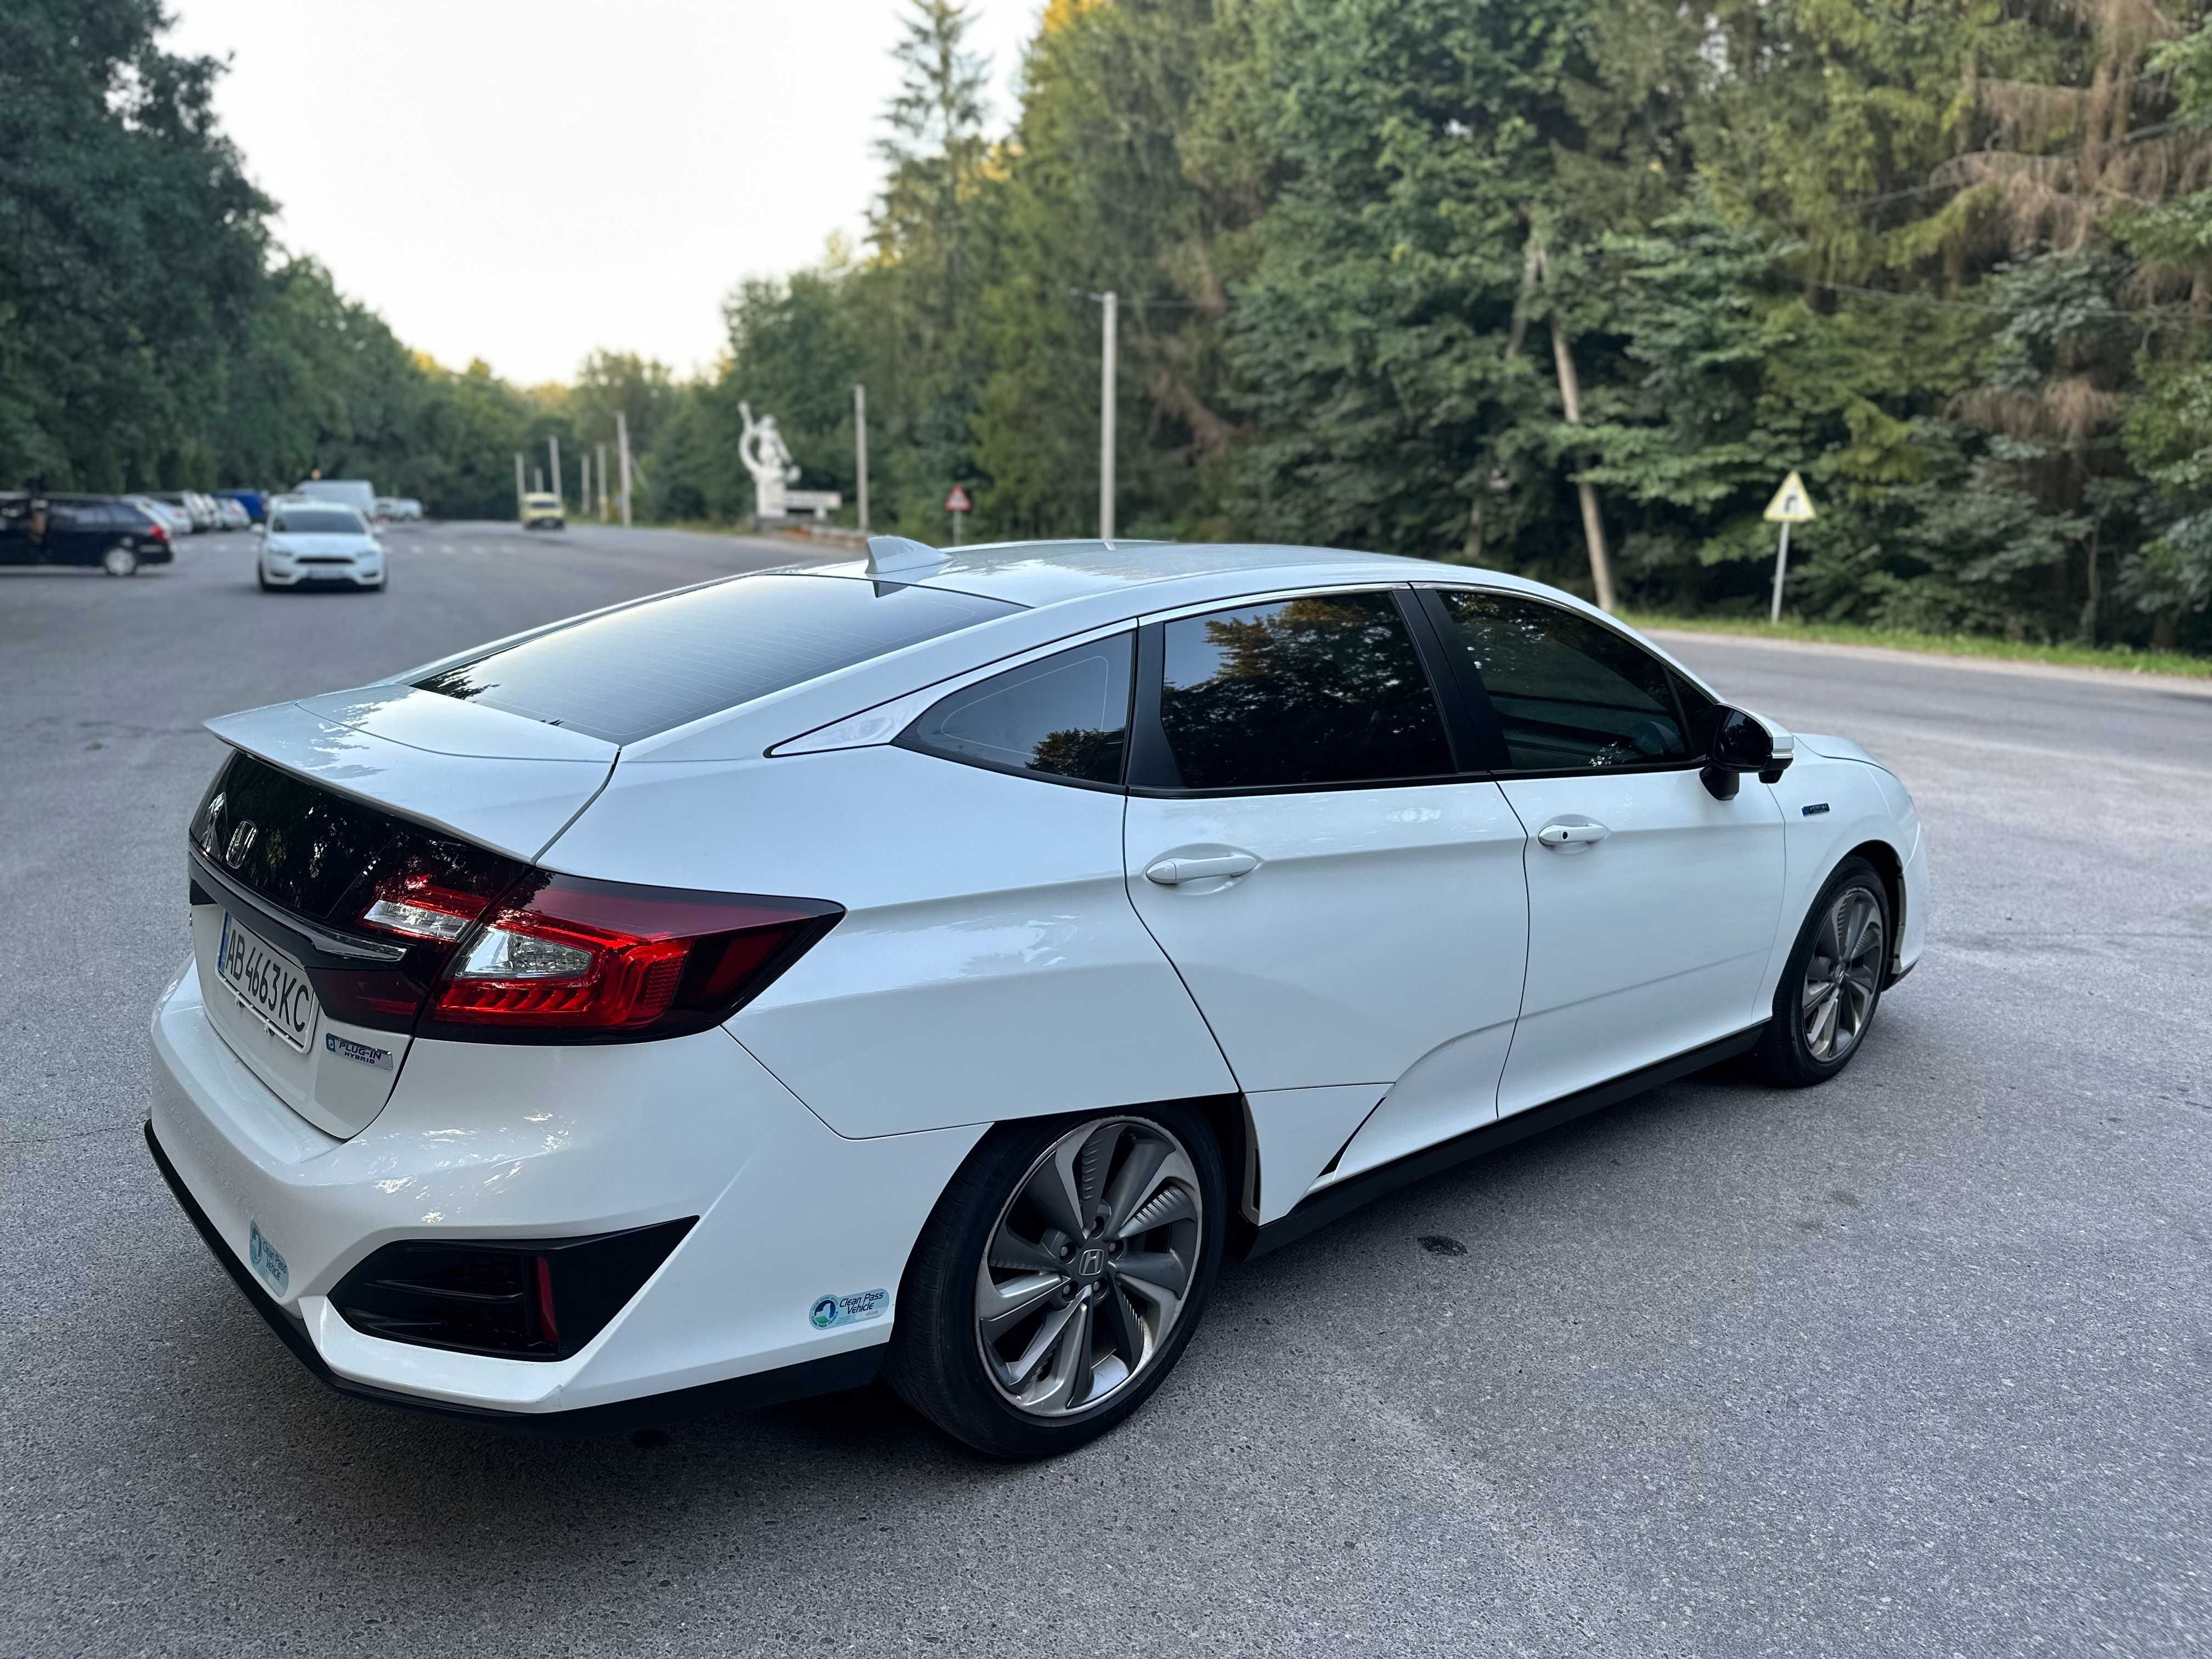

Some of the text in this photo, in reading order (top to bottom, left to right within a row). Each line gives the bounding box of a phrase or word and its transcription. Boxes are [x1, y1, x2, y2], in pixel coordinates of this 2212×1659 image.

[338, 1042, 382, 1060] PLUG-IN
[344, 1051, 375, 1064] HYBRID
[839, 1297, 862, 1307] Clean
[863, 1292, 884, 1304] Pass
[848, 1302, 874, 1314] Vehicle
